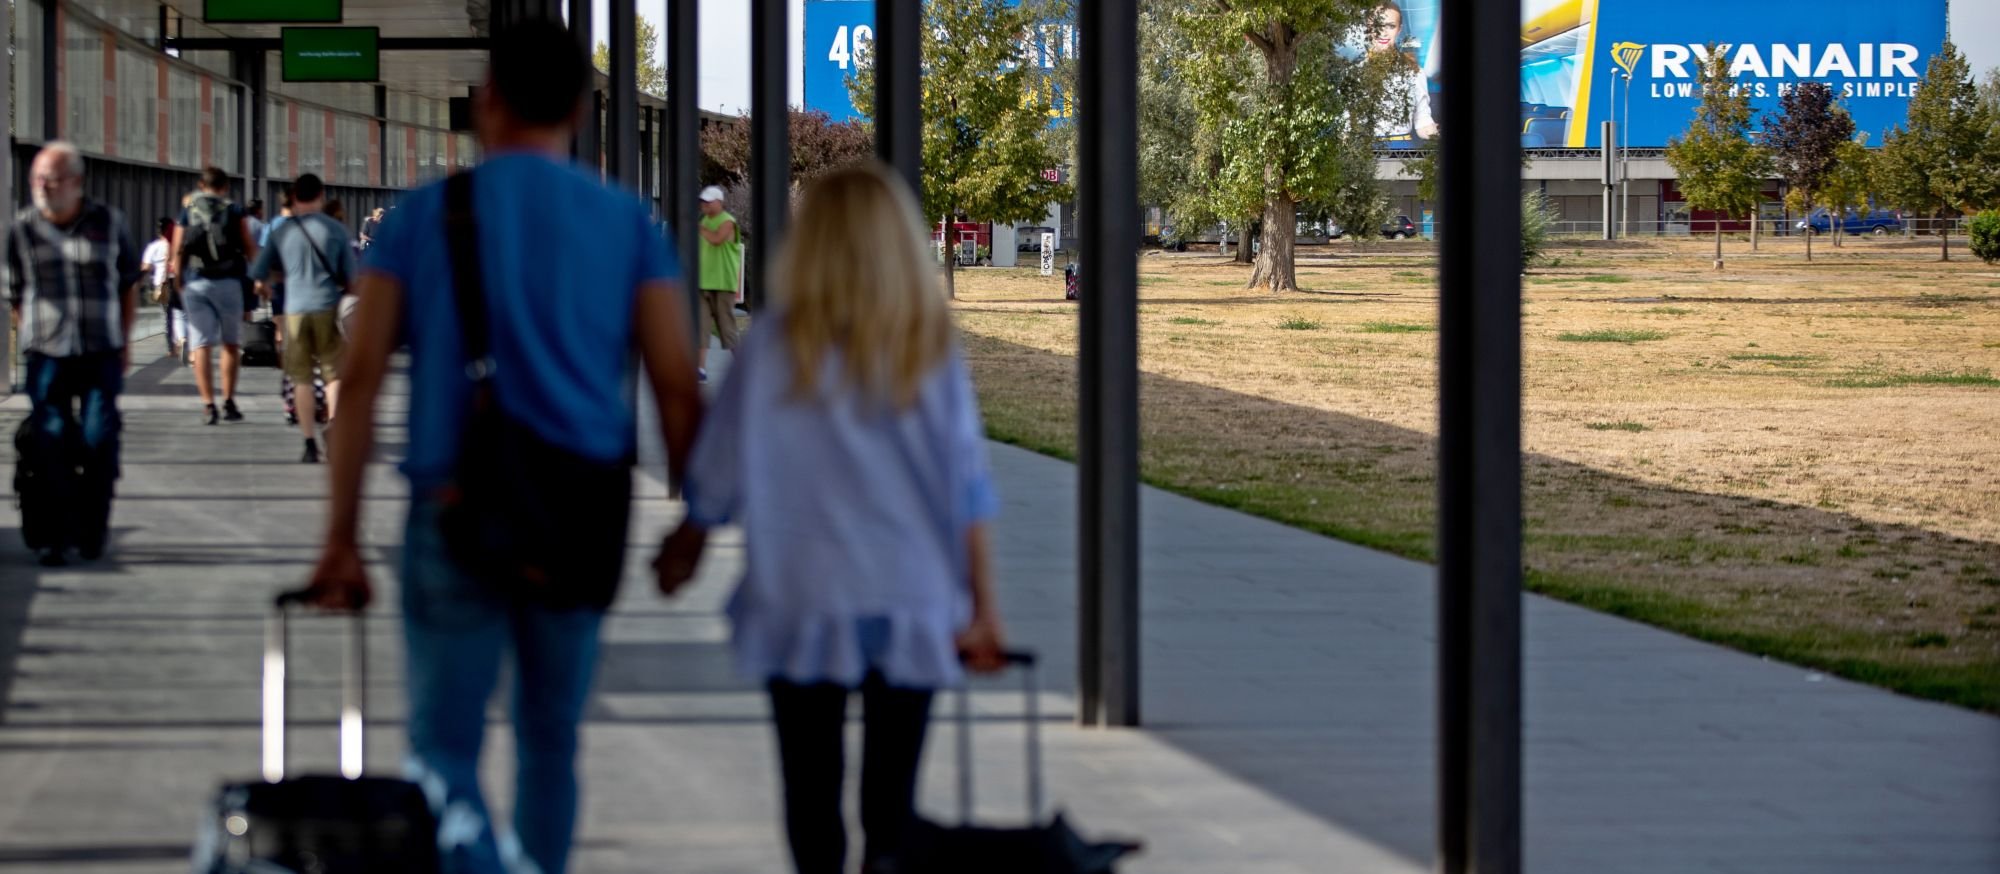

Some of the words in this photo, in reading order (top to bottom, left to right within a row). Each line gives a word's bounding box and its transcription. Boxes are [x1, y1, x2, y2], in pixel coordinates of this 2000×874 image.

[1651, 43, 1919, 78] RYANAIR
[1651, 82, 1693, 98] LOW
[1843, 82, 1919, 98] SIMPLE
